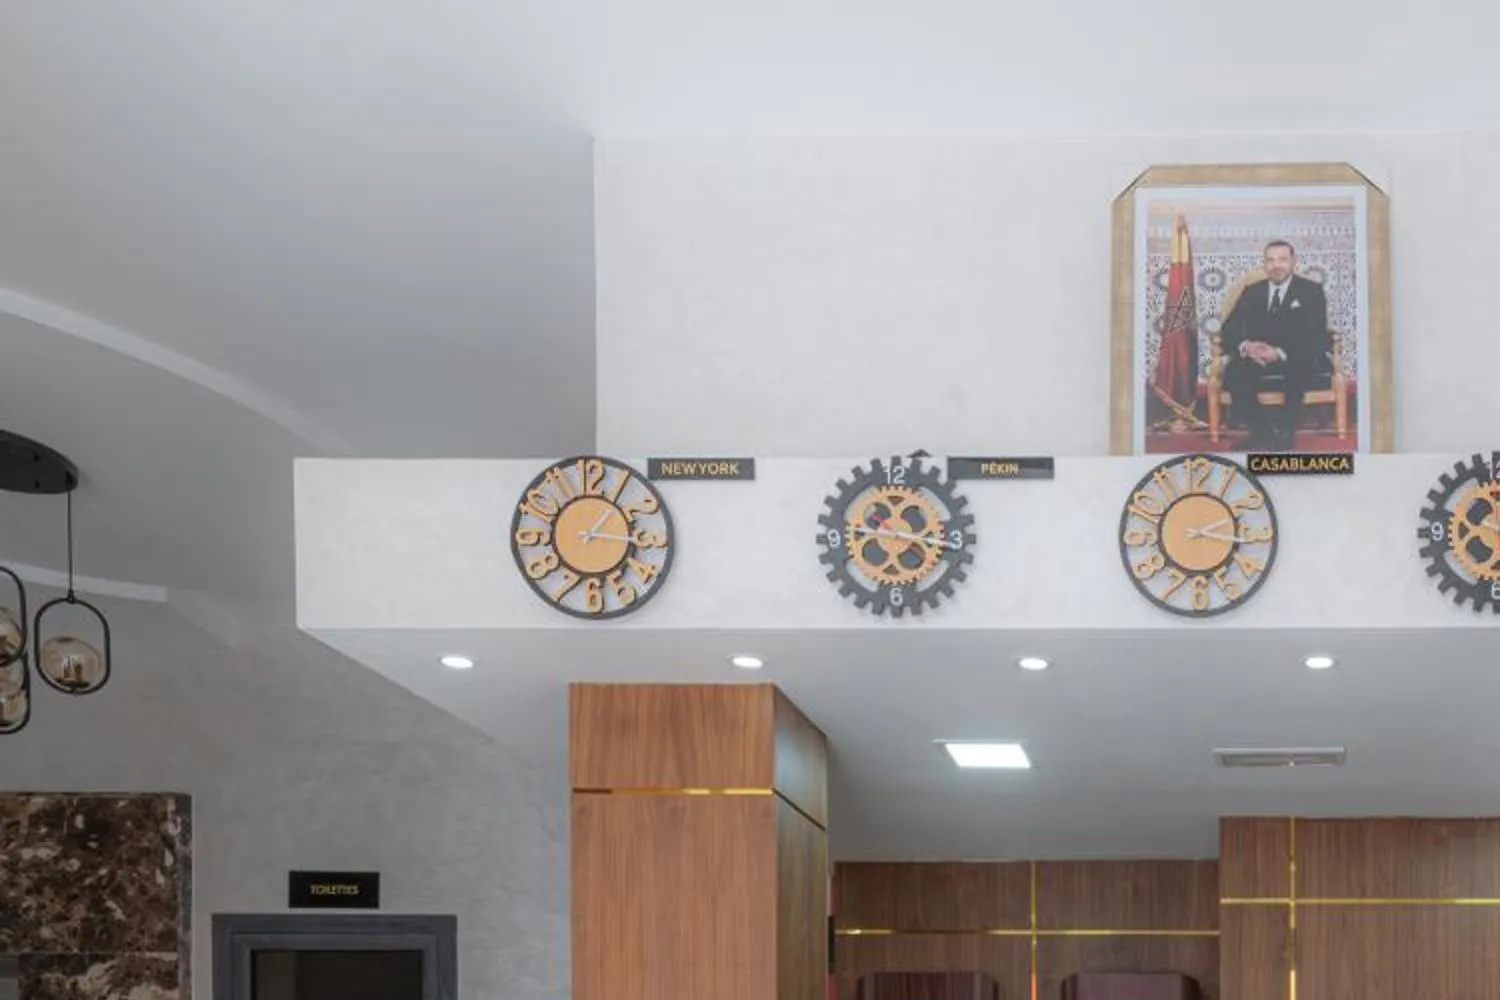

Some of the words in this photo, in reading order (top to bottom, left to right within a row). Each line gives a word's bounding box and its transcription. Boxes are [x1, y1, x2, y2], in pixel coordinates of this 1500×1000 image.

[576, 459, 605, 496] 12
[883, 465, 905, 485] 12
[1183, 458, 1213, 494] 12
[1251, 457, 1350, 471] CASABLANCA
[545, 467, 577, 502] 11
[610, 468, 631, 503] 1
[1154, 467, 1184, 501] 11
[1216, 466, 1236, 498] 1
[520, 488, 560, 523] 10
[624, 497, 659, 522] 2
[1128, 491, 1165, 525] 10
[1230, 490, 1265, 515] 2
[516, 528, 551, 545] 9
[632, 528, 668, 548] 3
[827, 529, 841, 548] 9
[950, 530, 963, 549] 3
[1124, 531, 1158, 546] 9
[1238, 524, 1273, 542] 3
[1431, 521, 1444, 541] 9
[527, 553, 560, 580] 8
[625, 556, 660, 584] 4
[1134, 553, 1165, 580] 8
[1234, 553, 1262, 579] 4
[551, 573, 582, 603] 7
[586, 576, 604, 614] 6
[607, 570, 637, 606] 5
[890, 587, 904, 606] 6
[1160, 568, 1187, 601] 7
[1192, 576, 1209, 610] 6
[1215, 566, 1242, 601] 5
